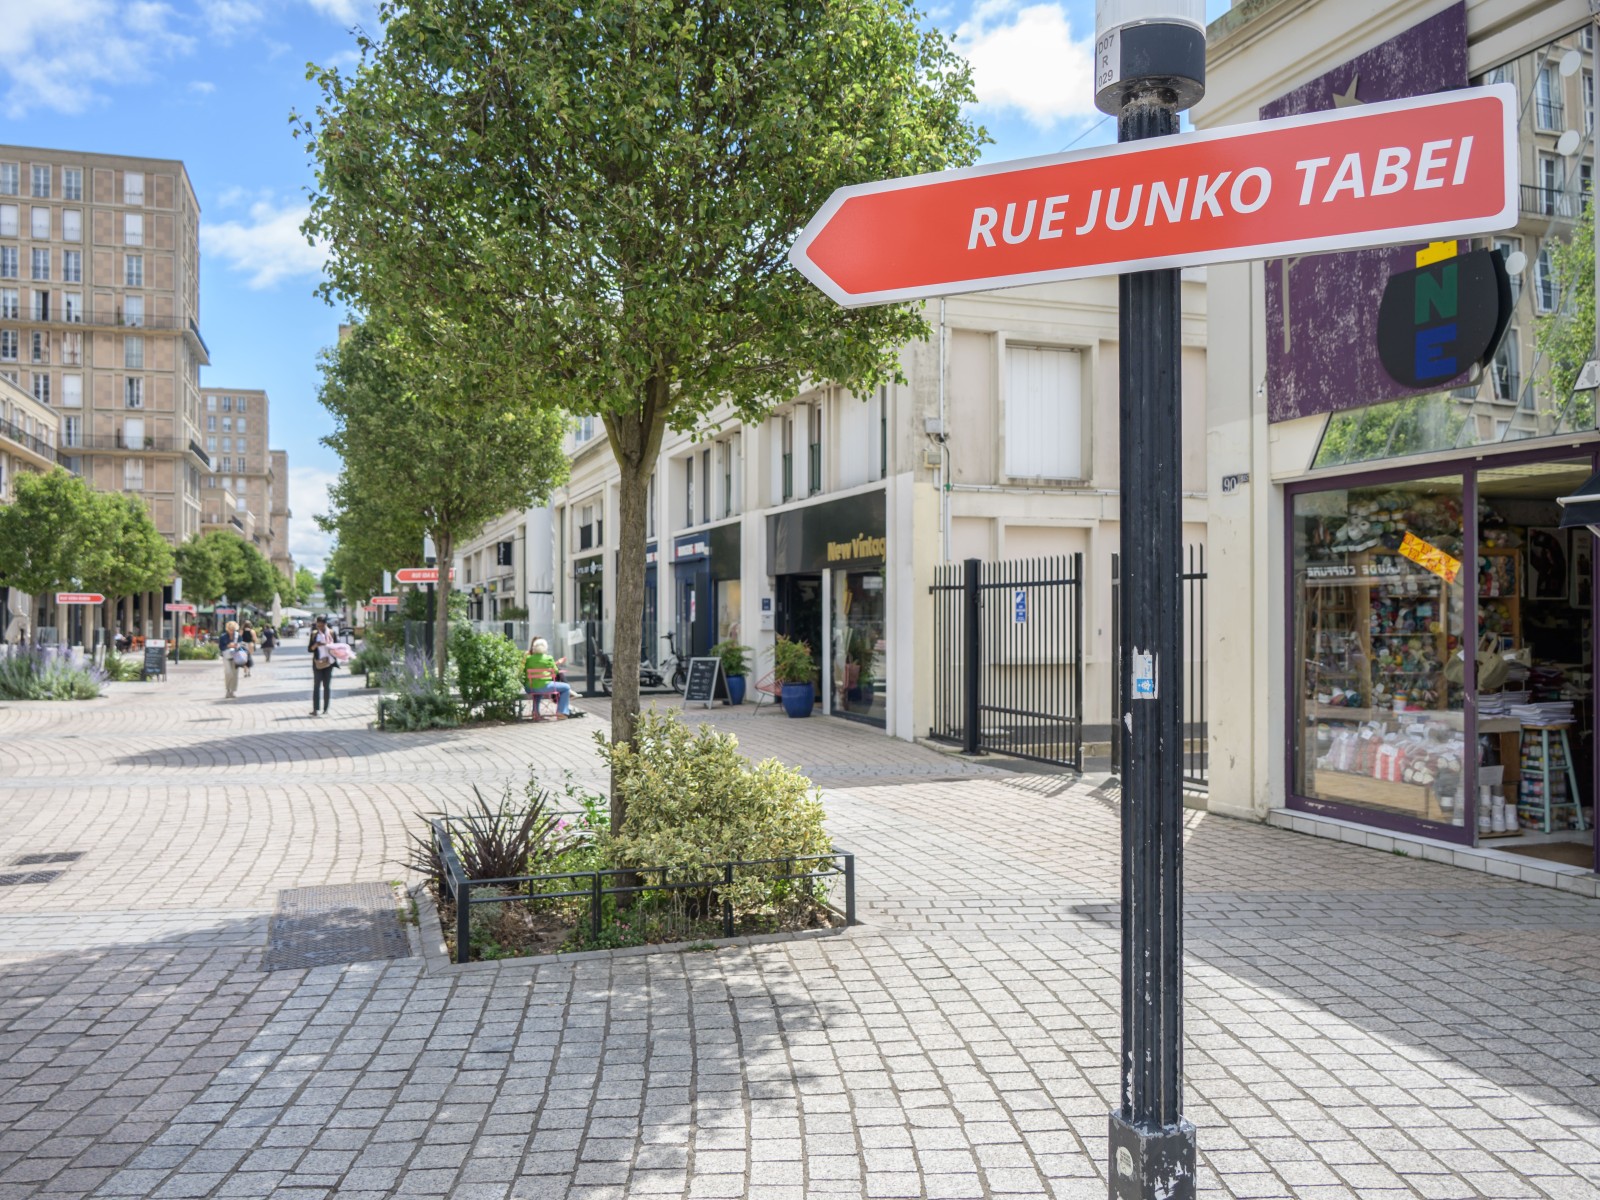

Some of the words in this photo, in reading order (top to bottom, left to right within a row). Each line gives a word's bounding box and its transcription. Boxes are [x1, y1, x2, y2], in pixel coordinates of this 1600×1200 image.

[1098, 34, 1115, 55] D07
[1102, 55, 1109, 68] R
[1098, 69, 1114, 88] 029
[967, 194, 1070, 250] RUE
[1075, 166, 1272, 236] JUNKO
[1295, 135, 1474, 206] TABEI
[1224, 477, 1237, 493] 90
[827, 541, 852, 562] New
[851, 532, 887, 563] Vintag
